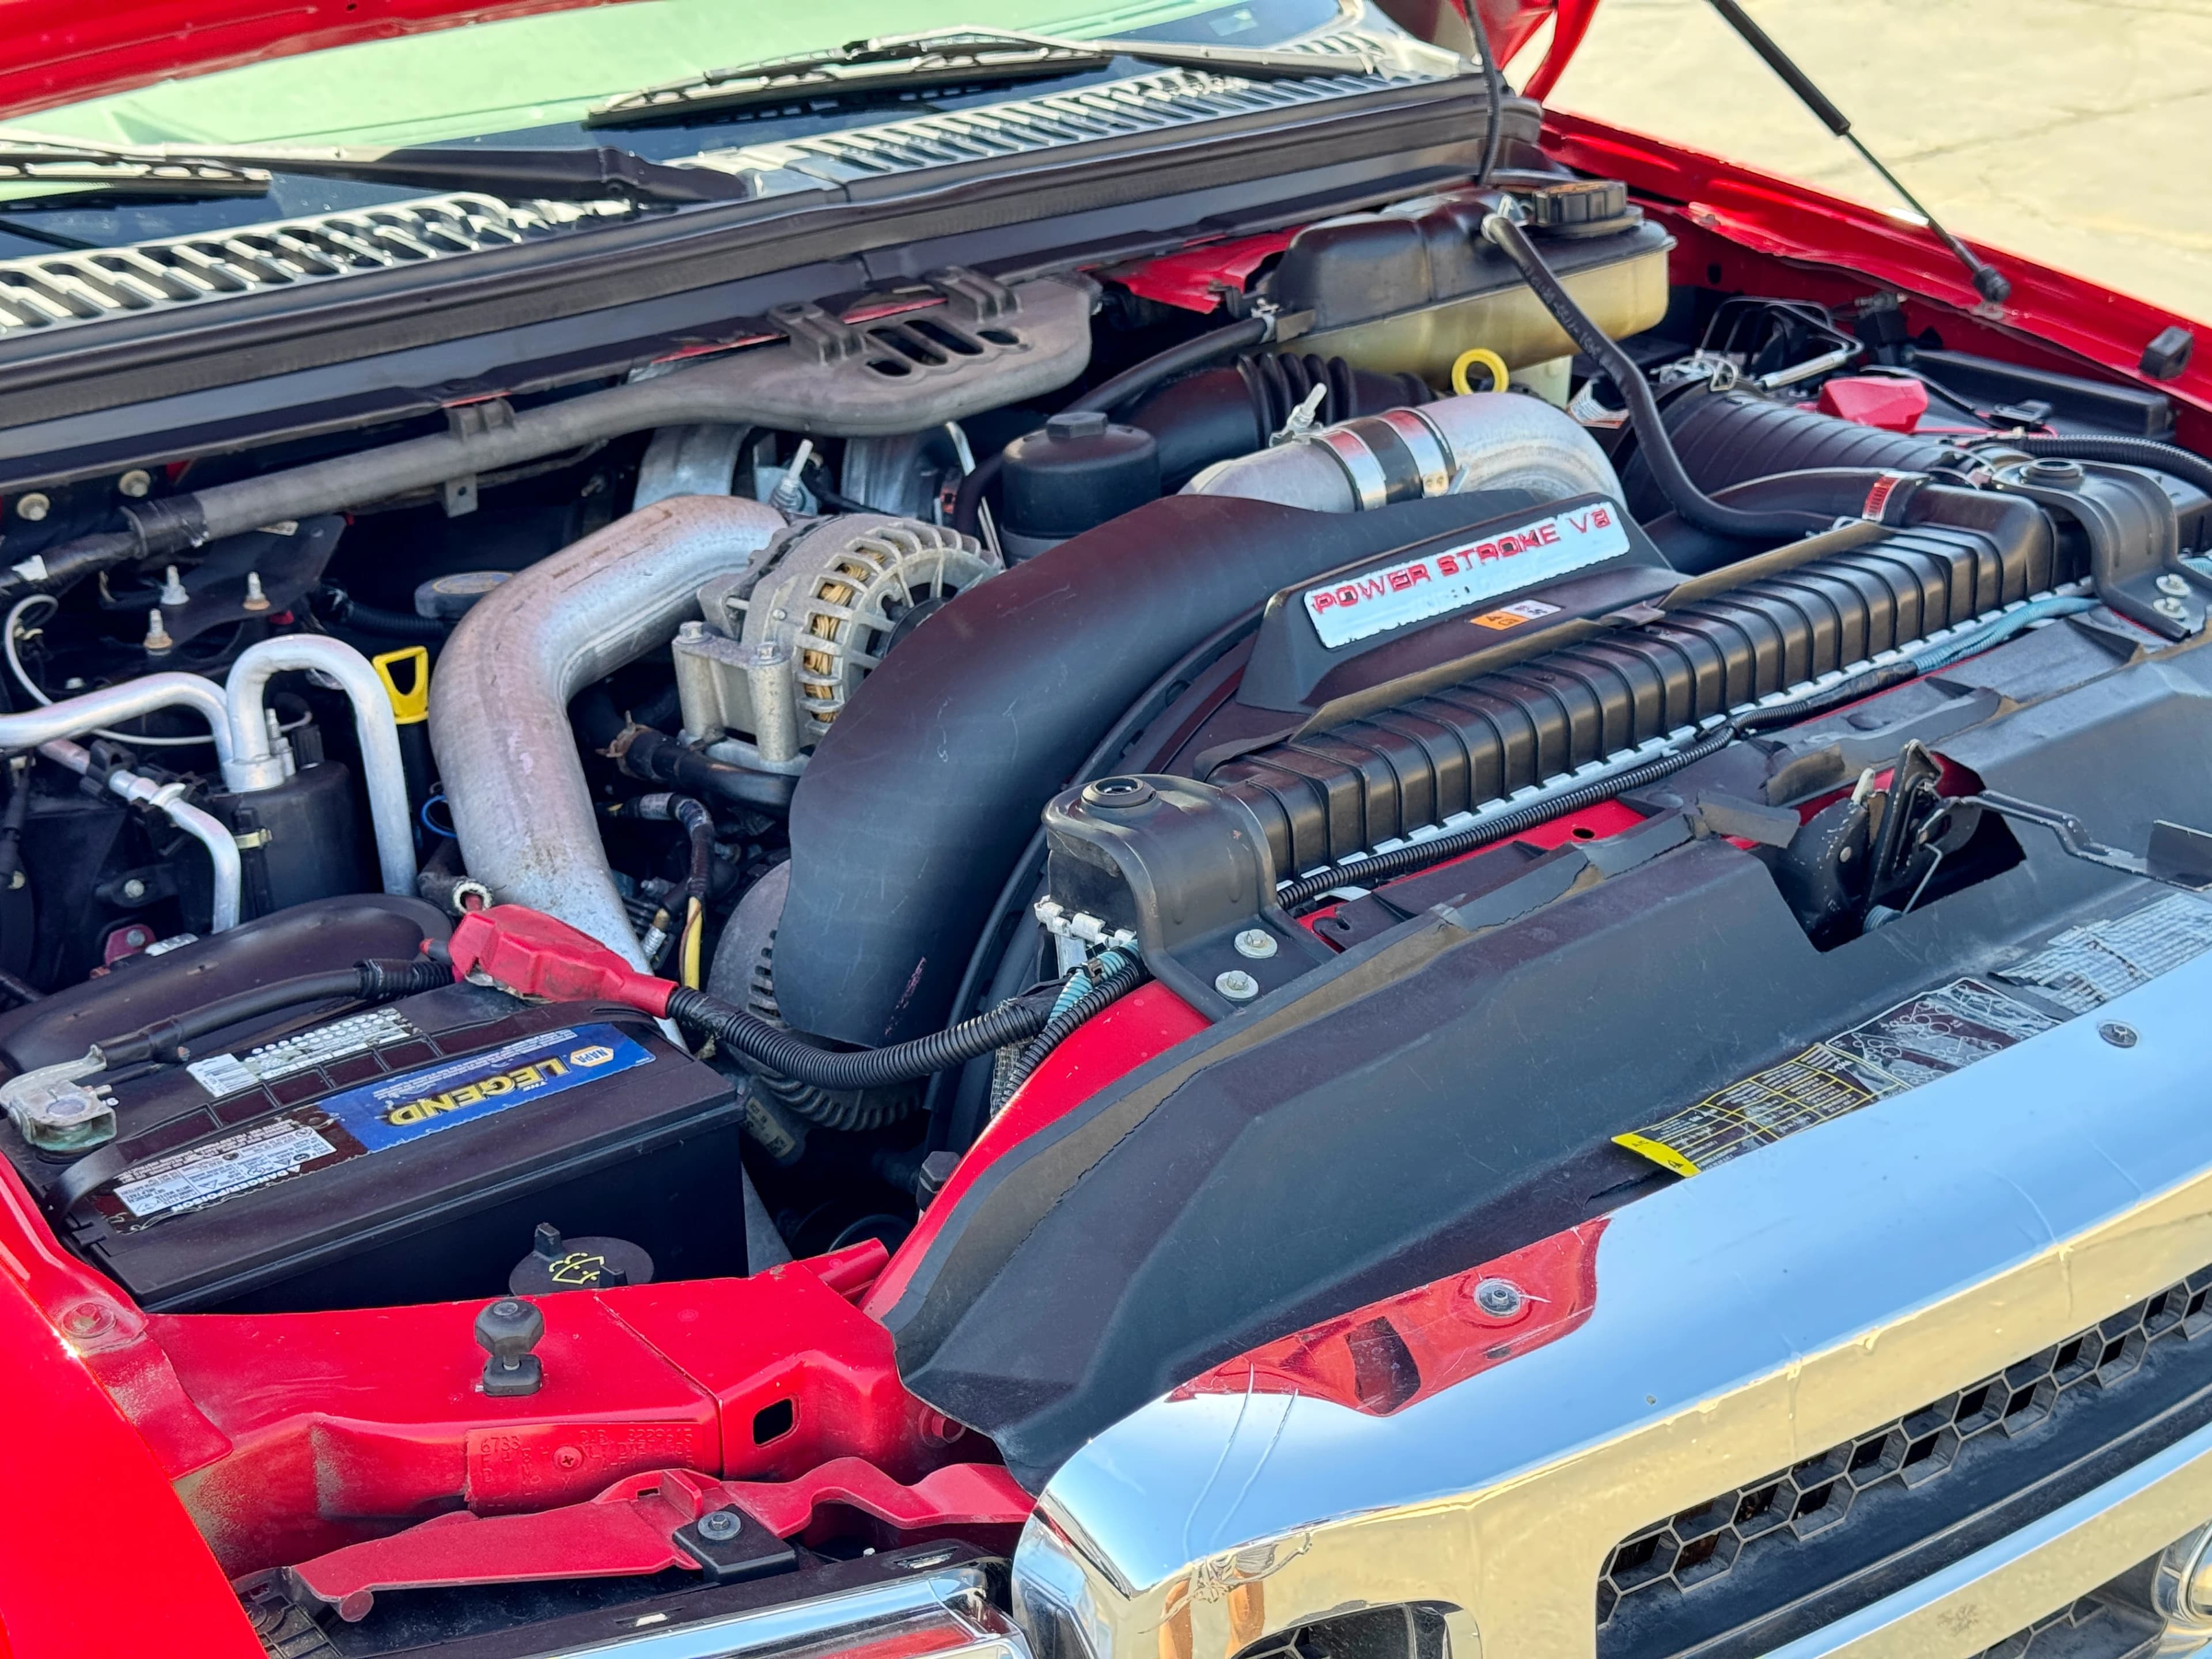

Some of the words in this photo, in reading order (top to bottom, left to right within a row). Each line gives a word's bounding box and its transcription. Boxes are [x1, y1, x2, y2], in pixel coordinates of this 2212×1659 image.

[1312, 563, 1431, 614] POWER
[1437, 522, 1560, 578] STROKE
[1569, 507, 1611, 533] V8
[574, 1048, 610, 1064] NAPA
[388, 1056, 571, 1126] LEGEND
[523, 1081, 547, 1092] THE
[168, 1168, 290, 1213] DANGER/POISON
